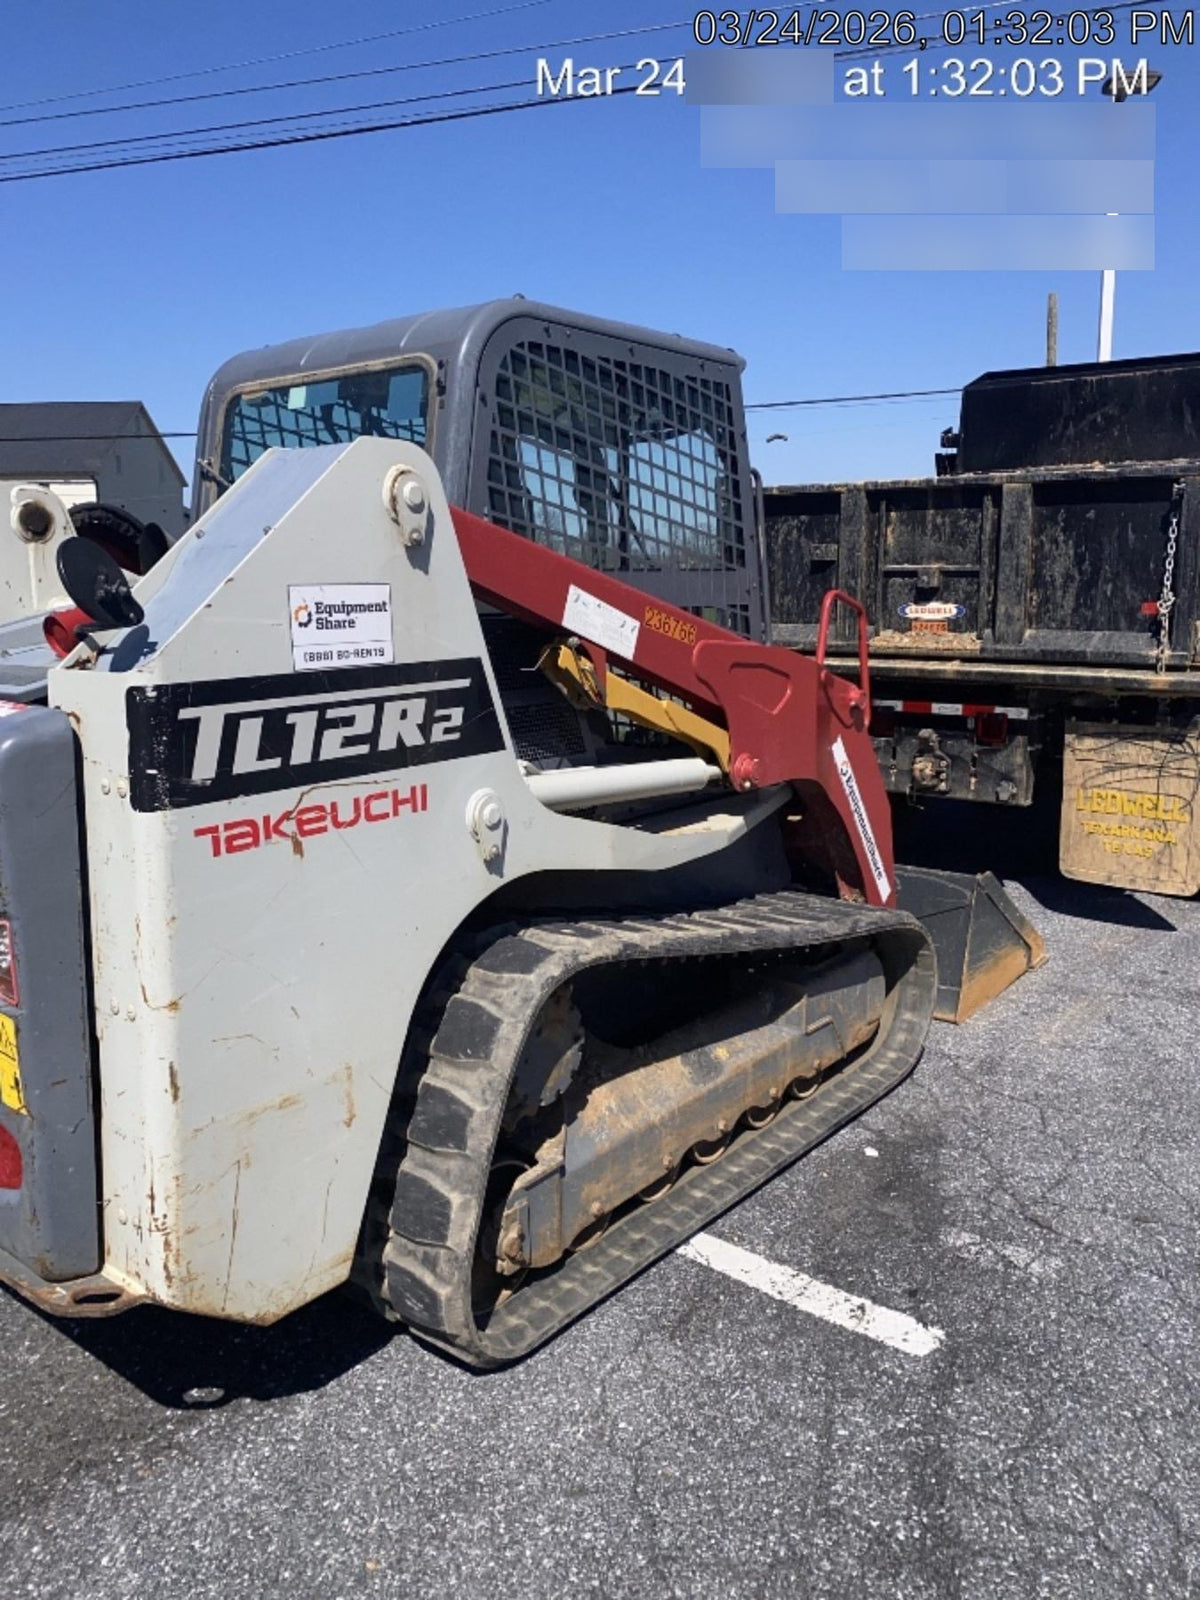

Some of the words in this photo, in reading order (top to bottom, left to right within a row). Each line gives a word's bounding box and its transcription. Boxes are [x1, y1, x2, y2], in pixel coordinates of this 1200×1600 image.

[314, 600, 388, 617] Equipment
[316, 617, 356, 630] Share
[177, 678, 472, 786] TL12R2
[1076, 787, 1190, 824] LEDWELL
